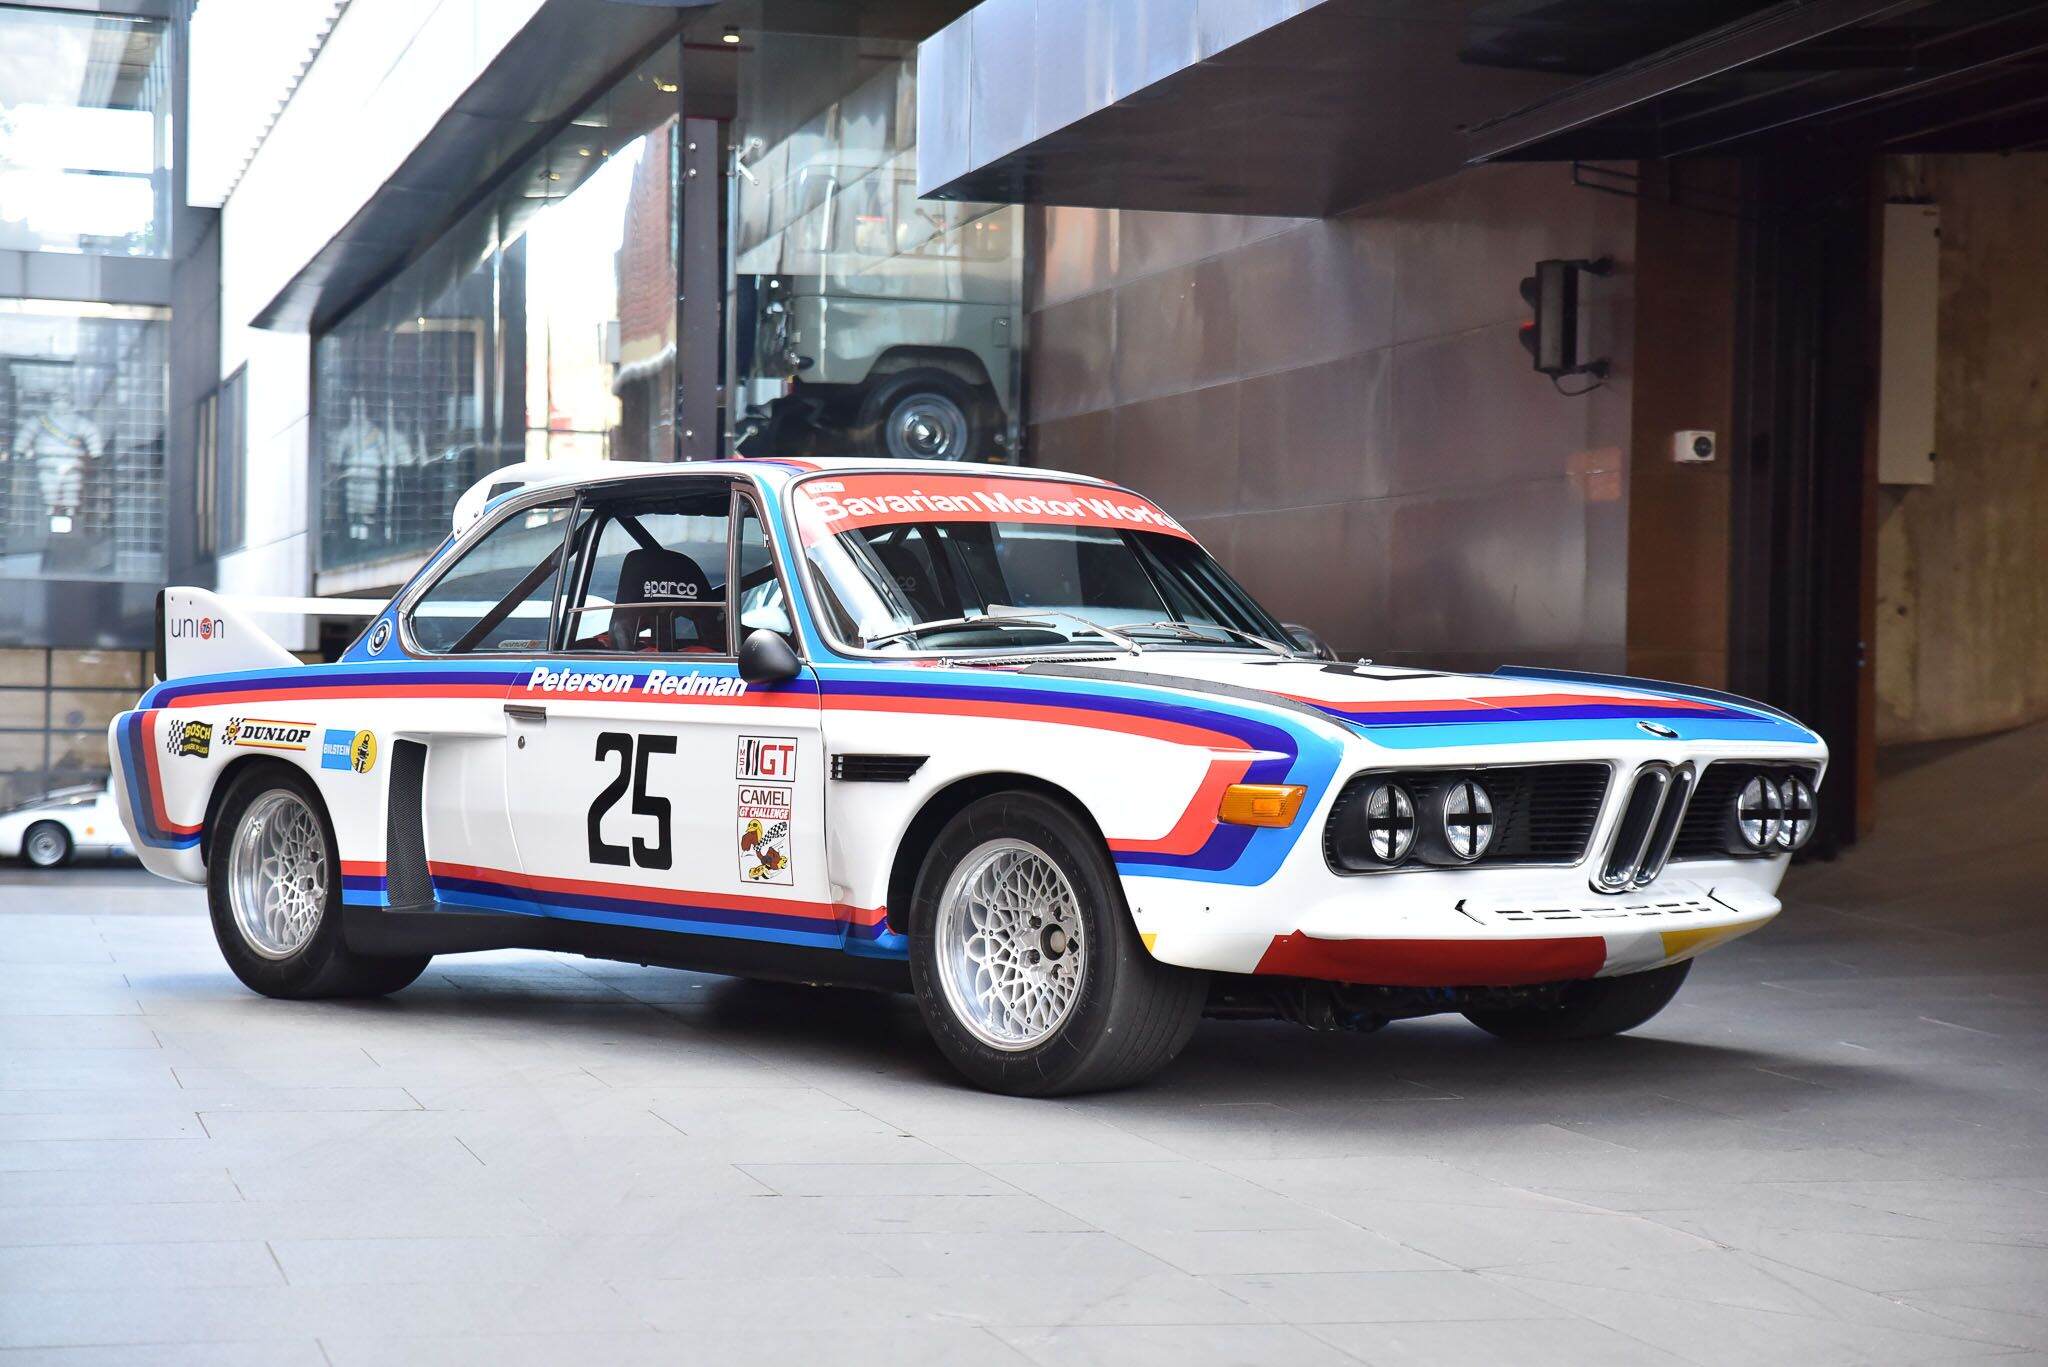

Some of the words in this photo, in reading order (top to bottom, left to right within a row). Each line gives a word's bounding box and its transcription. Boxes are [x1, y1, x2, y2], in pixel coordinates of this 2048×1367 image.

[812, 490, 982, 524] Bavarian
[972, 492, 1086, 517] Motor
[644, 581, 697, 597] sparco
[527, 666, 634, 693] Peterson
[642, 669, 748, 697] Redman
[185, 724, 211, 739] BOSCH
[241, 725, 311, 743] DUNLOP
[323, 743, 350, 755] BILSTEIN
[760, 745, 794, 775] GT
[587, 731, 678, 871] 25
[740, 789, 789, 806] CAMEL
[740, 807, 749, 817] GT
[749, 808, 790, 820] CHALLENGE
